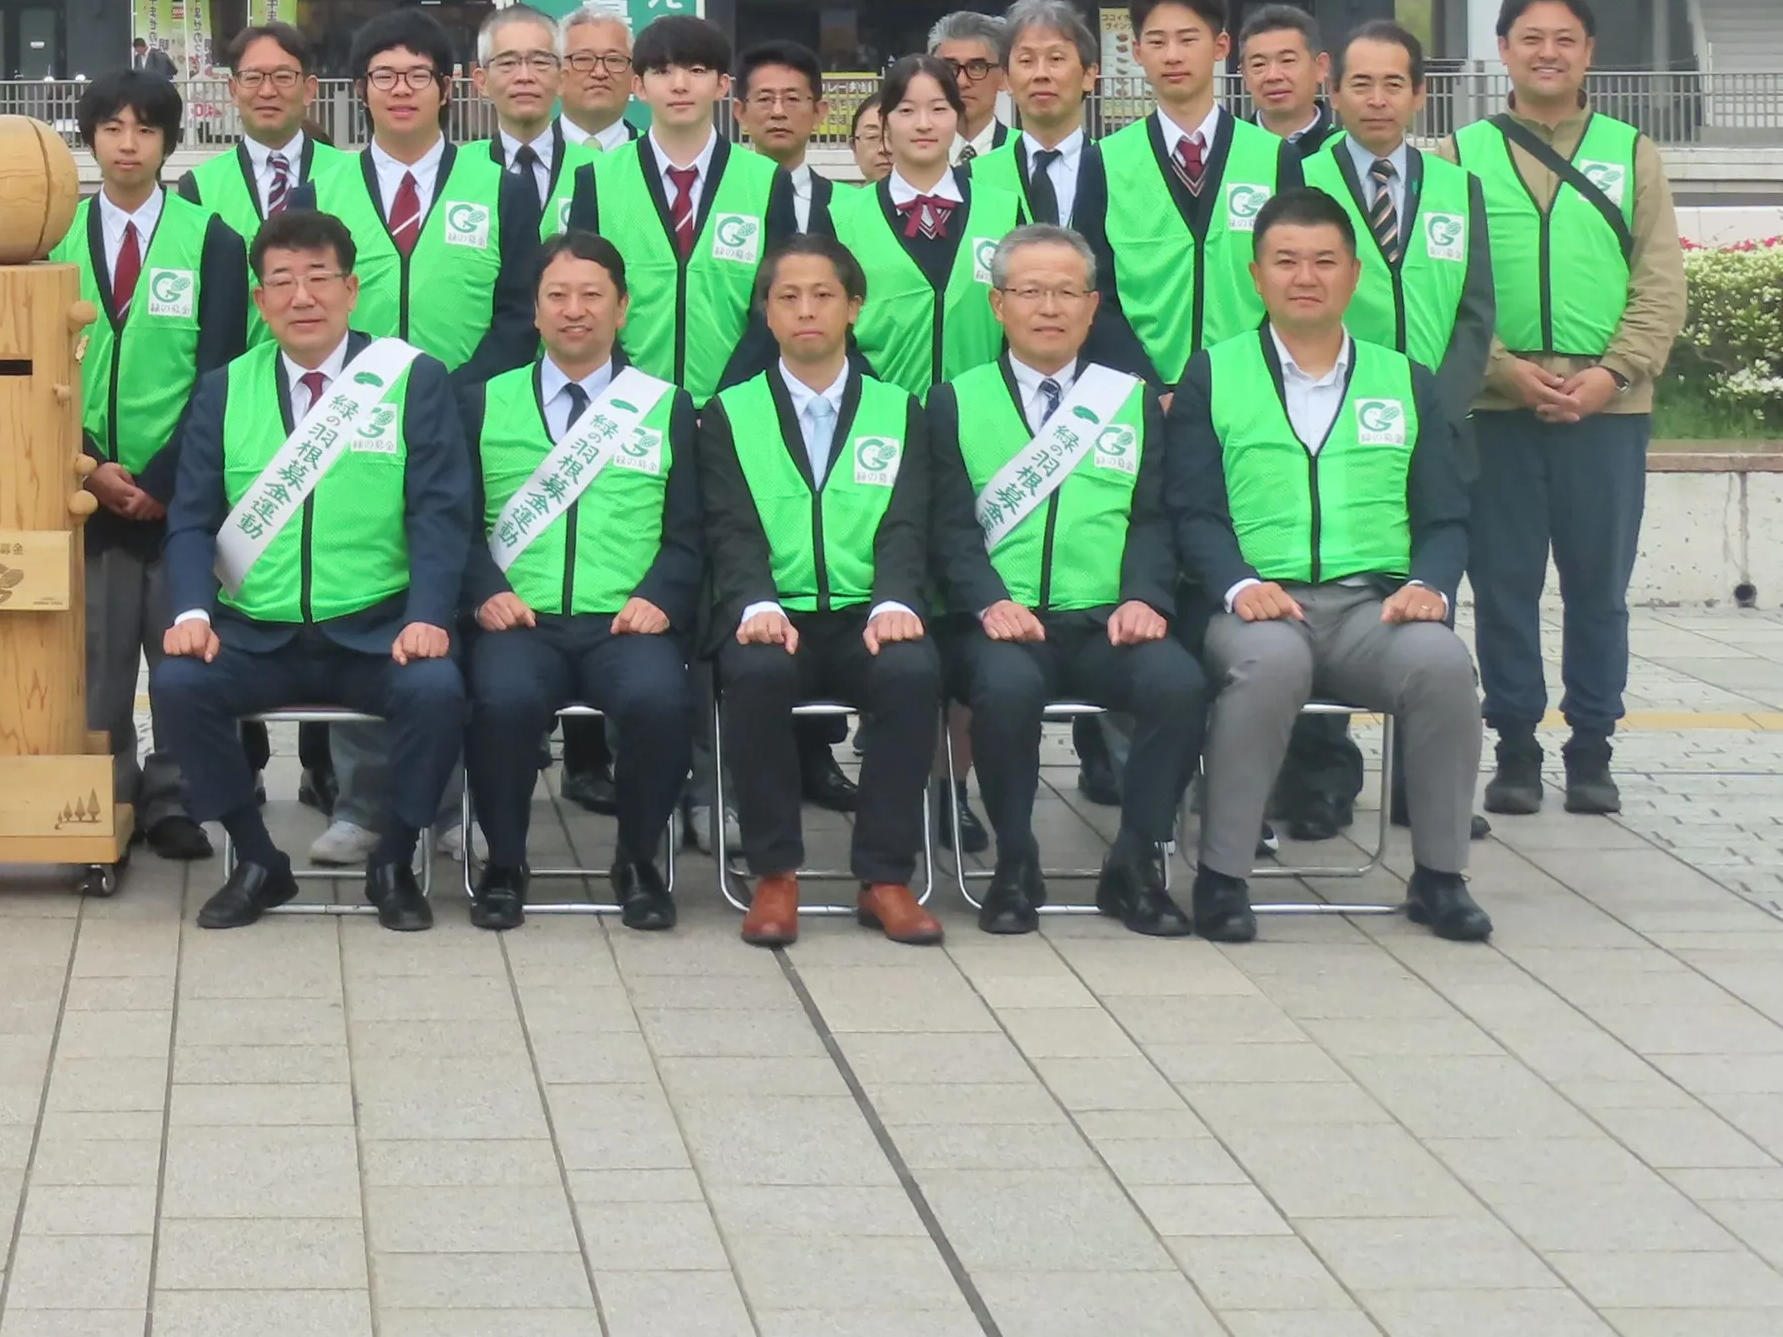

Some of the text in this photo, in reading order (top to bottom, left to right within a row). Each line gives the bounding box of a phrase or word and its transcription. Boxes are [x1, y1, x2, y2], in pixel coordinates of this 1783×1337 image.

[236, 393, 360, 541] 緑の羽根募金運動
[498, 413, 619, 549] 緑の羽根募金運動
